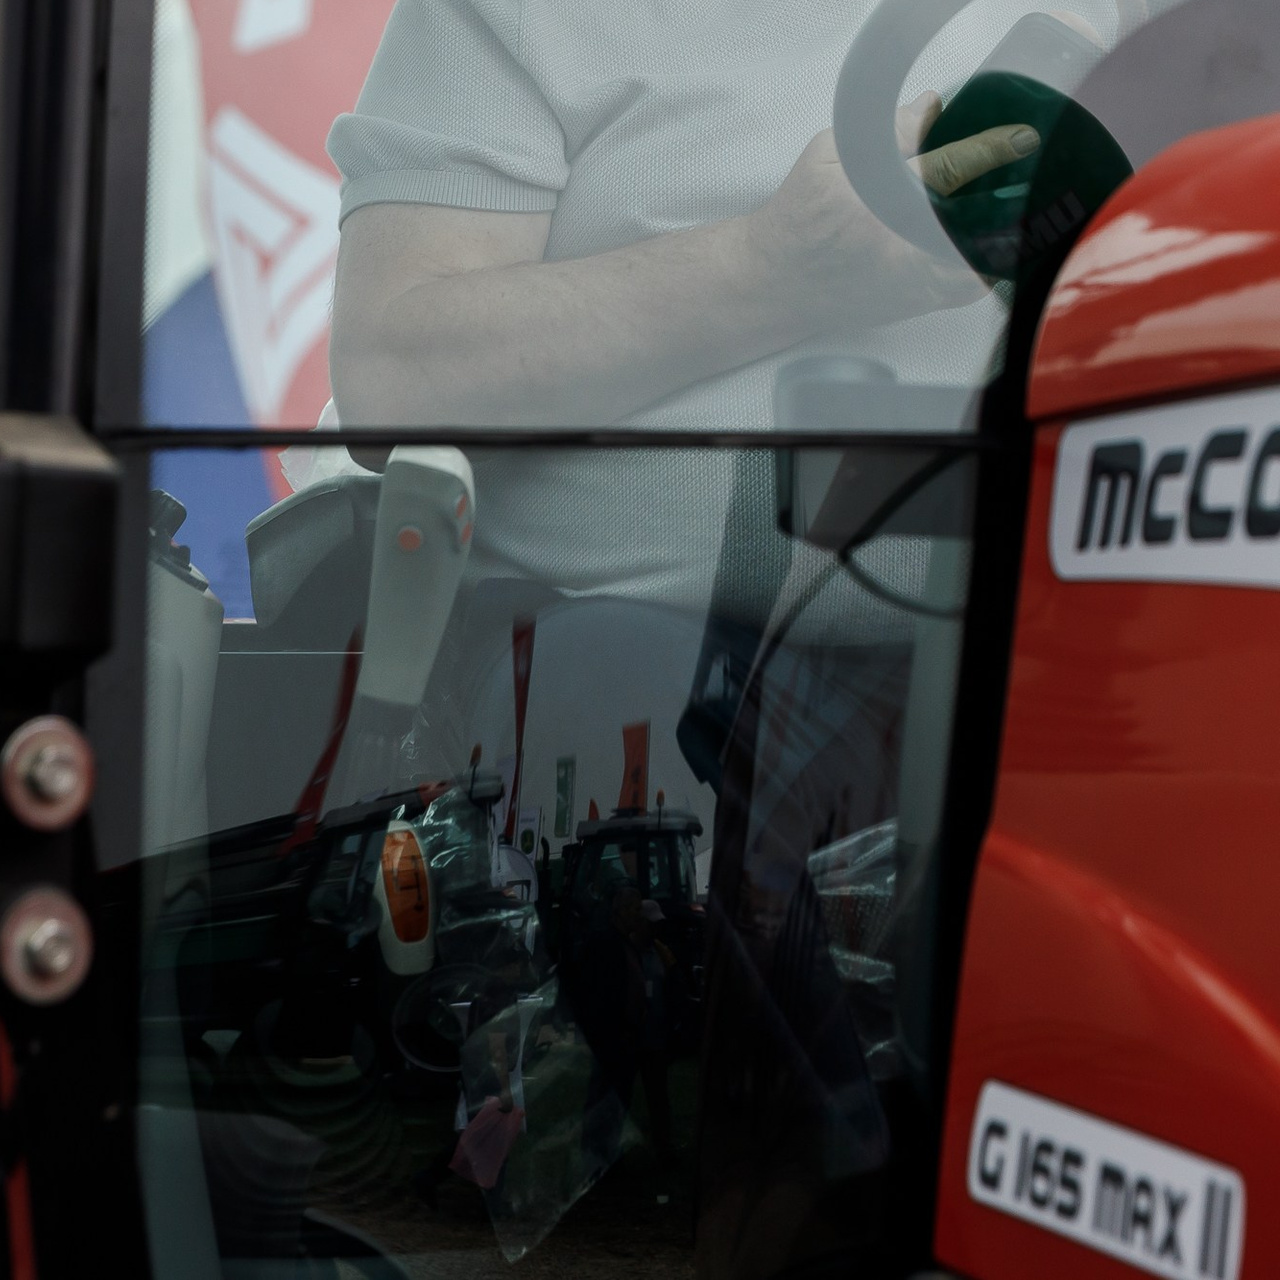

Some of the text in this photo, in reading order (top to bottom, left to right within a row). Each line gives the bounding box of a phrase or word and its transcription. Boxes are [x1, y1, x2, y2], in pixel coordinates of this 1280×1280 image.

[978, 1120, 1008, 1190] G
[1015, 1130, 1084, 1220] 165
[1092, 1161, 1188, 1265] MAX
